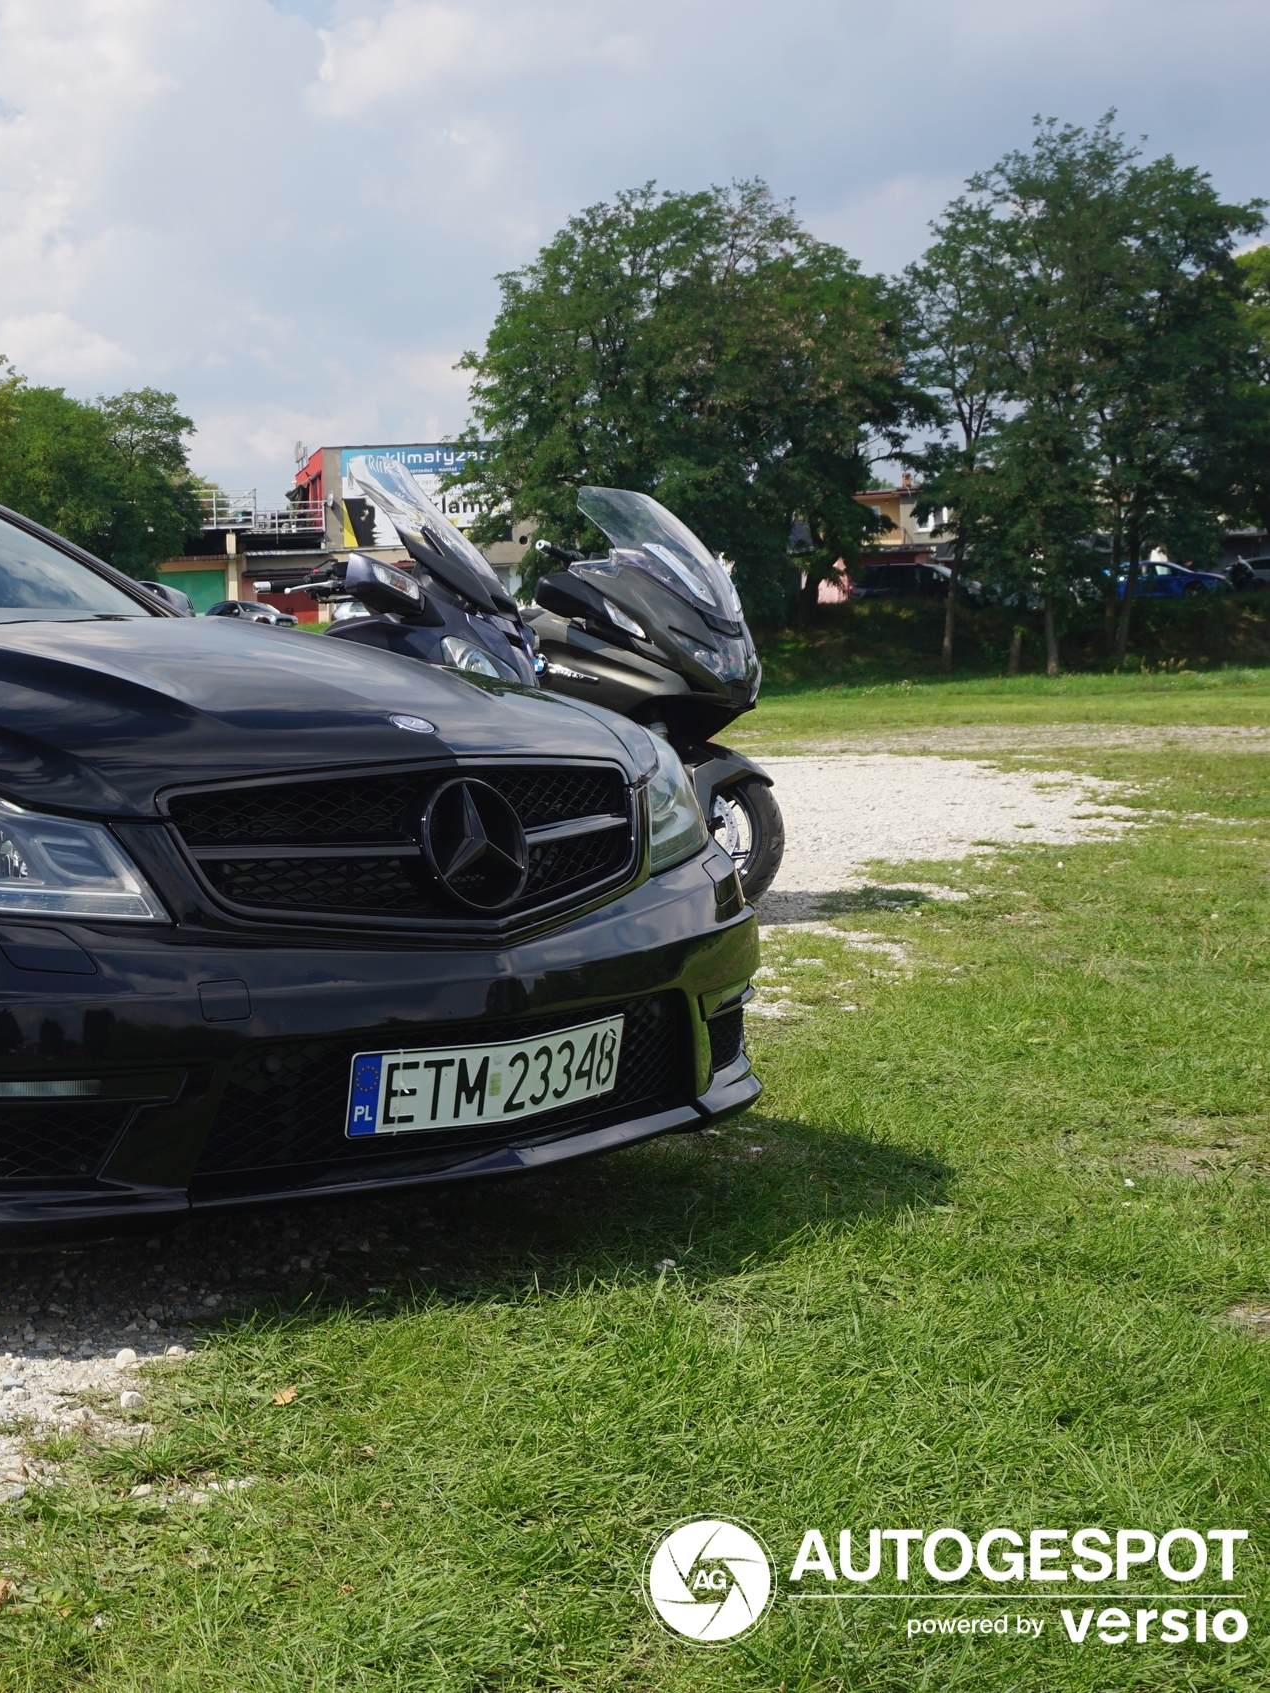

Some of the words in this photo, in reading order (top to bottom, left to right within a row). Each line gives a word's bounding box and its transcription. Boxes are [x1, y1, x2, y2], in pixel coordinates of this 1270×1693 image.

[382, 1055, 490, 1124] ETM
[503, 1028, 617, 1114] 23348
[353, 1105, 373, 1122] PL
